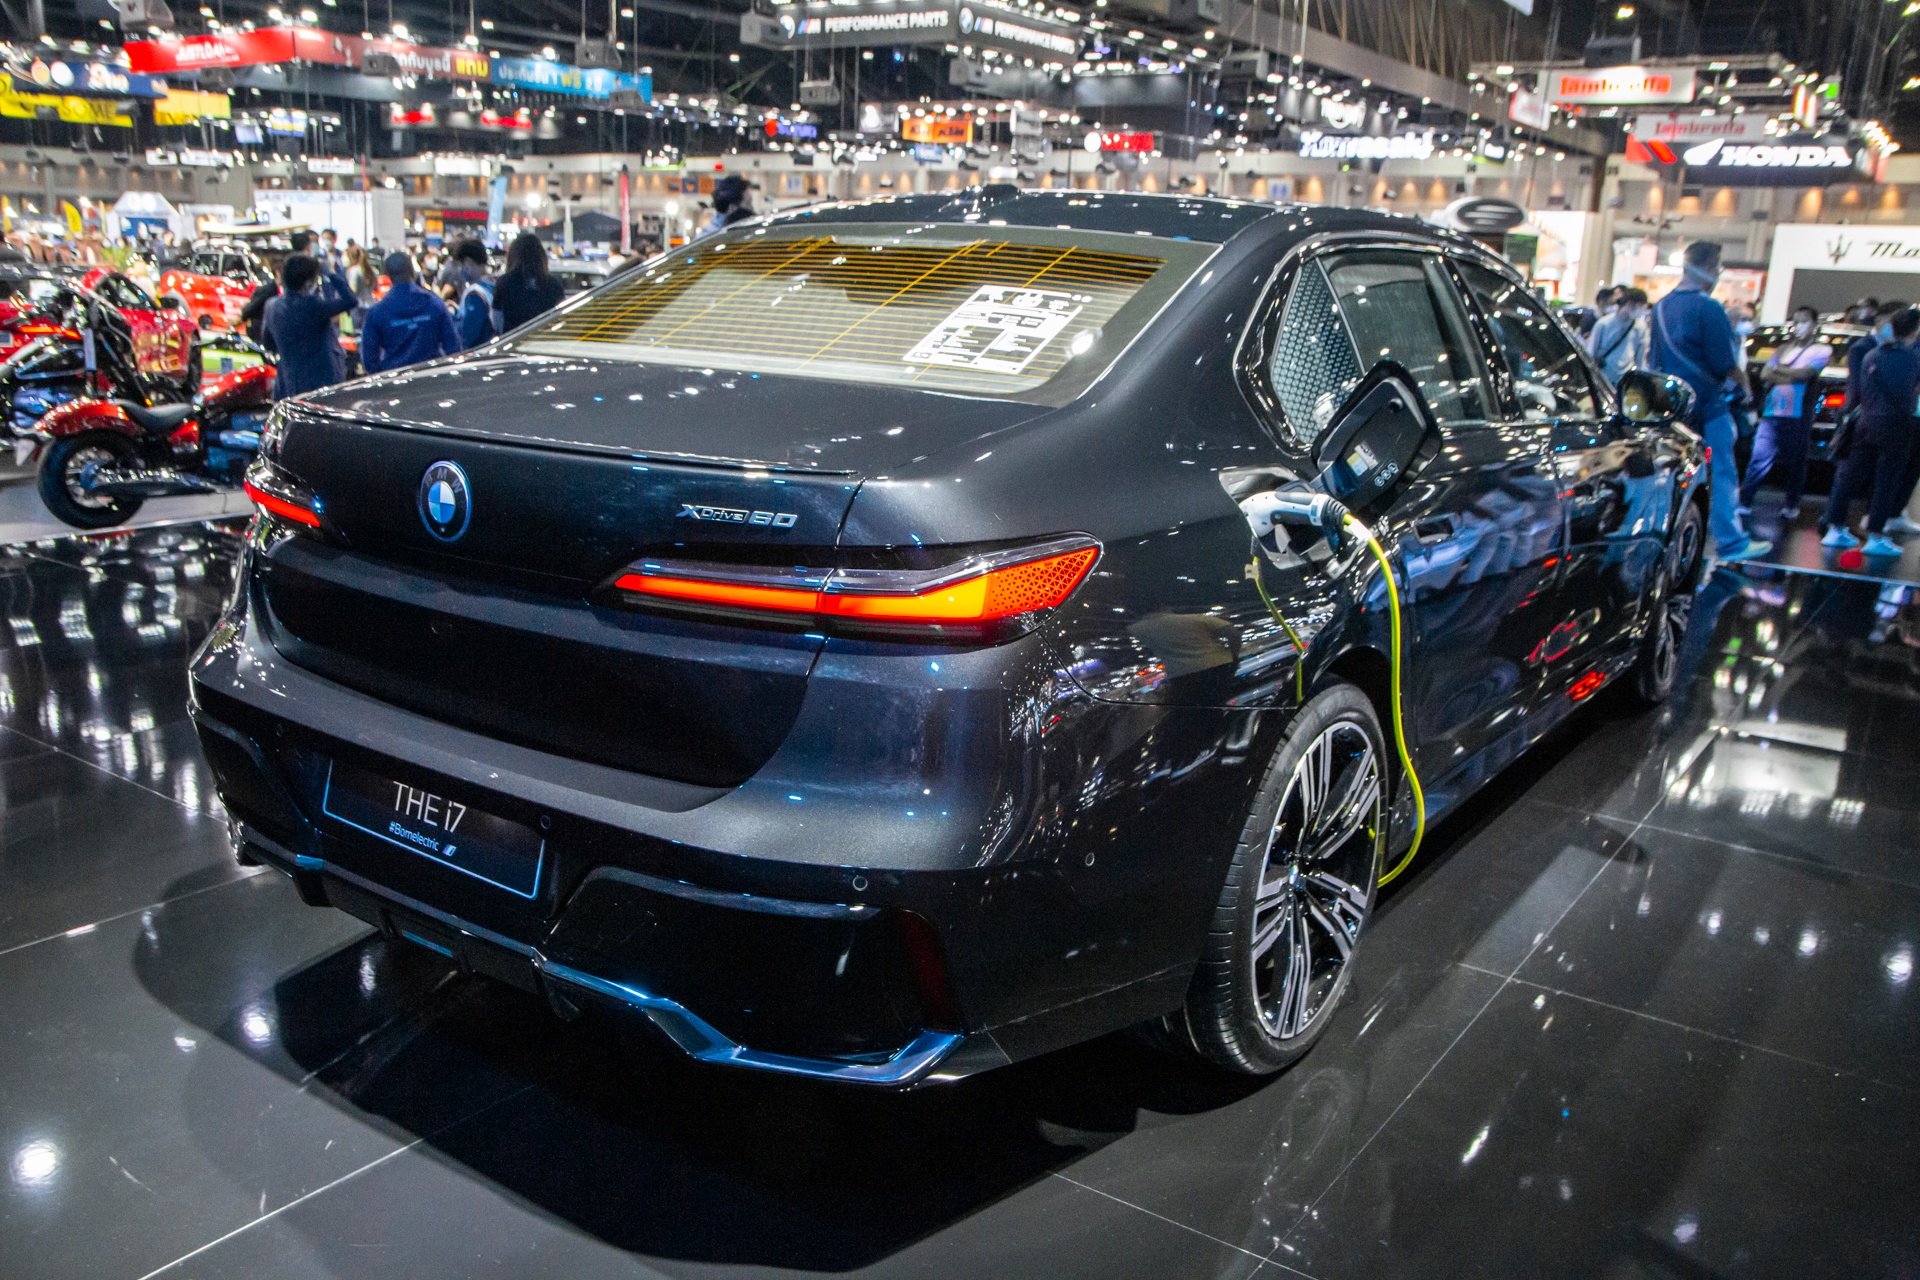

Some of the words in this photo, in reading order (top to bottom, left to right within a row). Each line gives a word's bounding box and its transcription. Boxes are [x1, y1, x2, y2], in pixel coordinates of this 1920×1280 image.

[824, 13, 908, 33] PERFORMANCE
[909, 10, 949, 29] PARTS
[1559, 75, 1671, 96] lambtta
[1655, 121, 1746, 135] lambretta
[1719, 145, 1853, 167] HONDA
[393, 780, 442, 826] THE
[443, 800, 467, 833] i7
